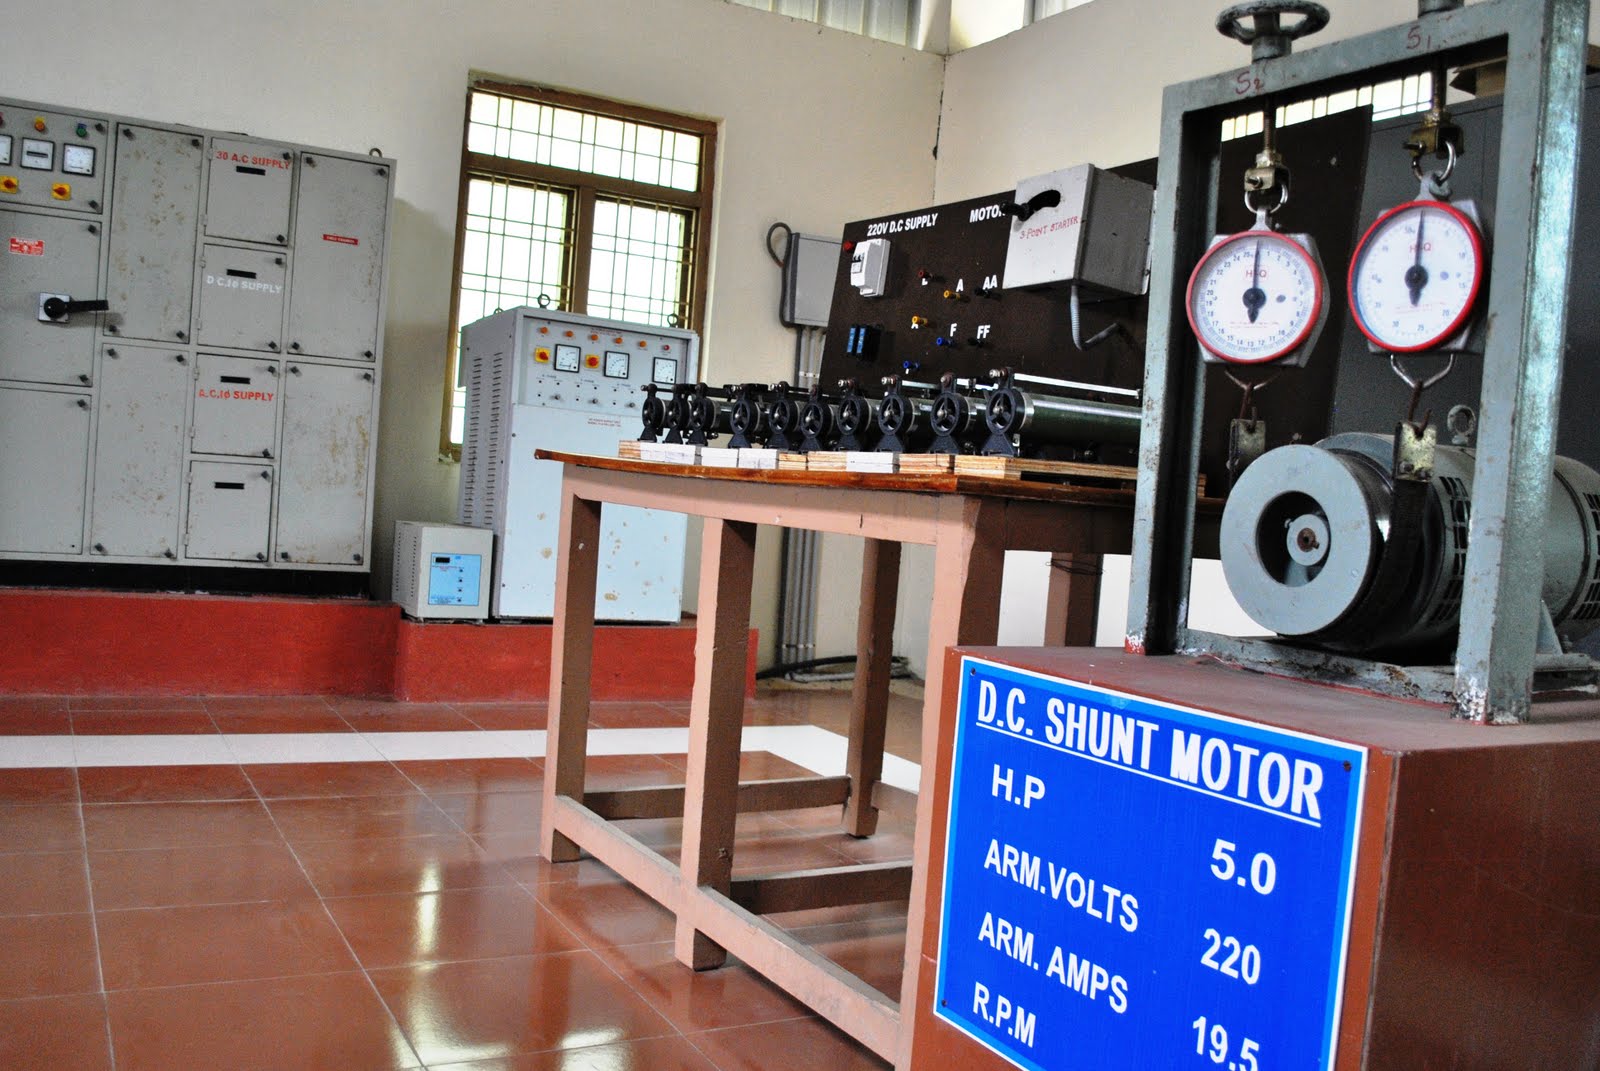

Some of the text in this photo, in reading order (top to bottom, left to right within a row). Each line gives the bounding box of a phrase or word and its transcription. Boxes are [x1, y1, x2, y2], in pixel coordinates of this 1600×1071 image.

[251, 156, 290, 170] SUPPLY
[867, 213, 939, 237] 220V D.C SUPPLY
[241, 280, 283, 294] SUPPLY
[955, 278, 964, 292] A
[982, 275, 998, 290] AA
[949, 323, 958, 337] F
[976, 325, 991, 339] FF
[233, 390, 275, 401] SUPPLY
[978, 679, 1323, 820] D.C. SHUNT MOTOR
[992, 763, 1276, 895] H.P 5.0
[1200, 928, 1261, 985] 220
[978, 911, 1260, 1071] ARM. AMPS 19.5
[972, 981, 1037, 1048] R.P.M
